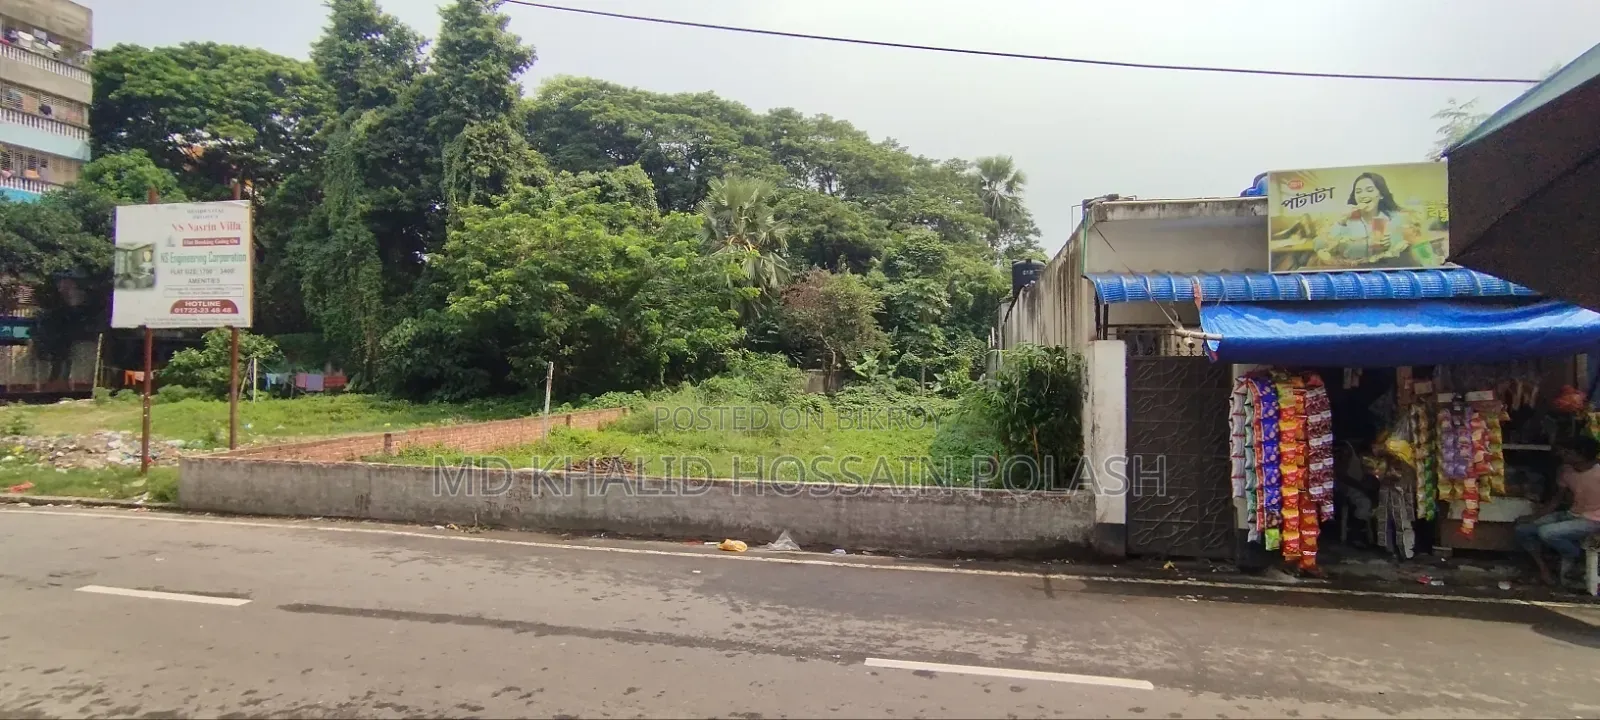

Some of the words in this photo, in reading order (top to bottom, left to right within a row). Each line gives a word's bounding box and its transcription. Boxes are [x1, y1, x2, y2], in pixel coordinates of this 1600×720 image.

[1281, 186, 1336, 210] পটাটা
[188, 222, 217, 232] Nasrin
[220, 221, 241, 231] Villa
[161, 252, 169, 263] NS
[170, 252, 207, 264] Engineering
[208, 251, 247, 264] Corporation
